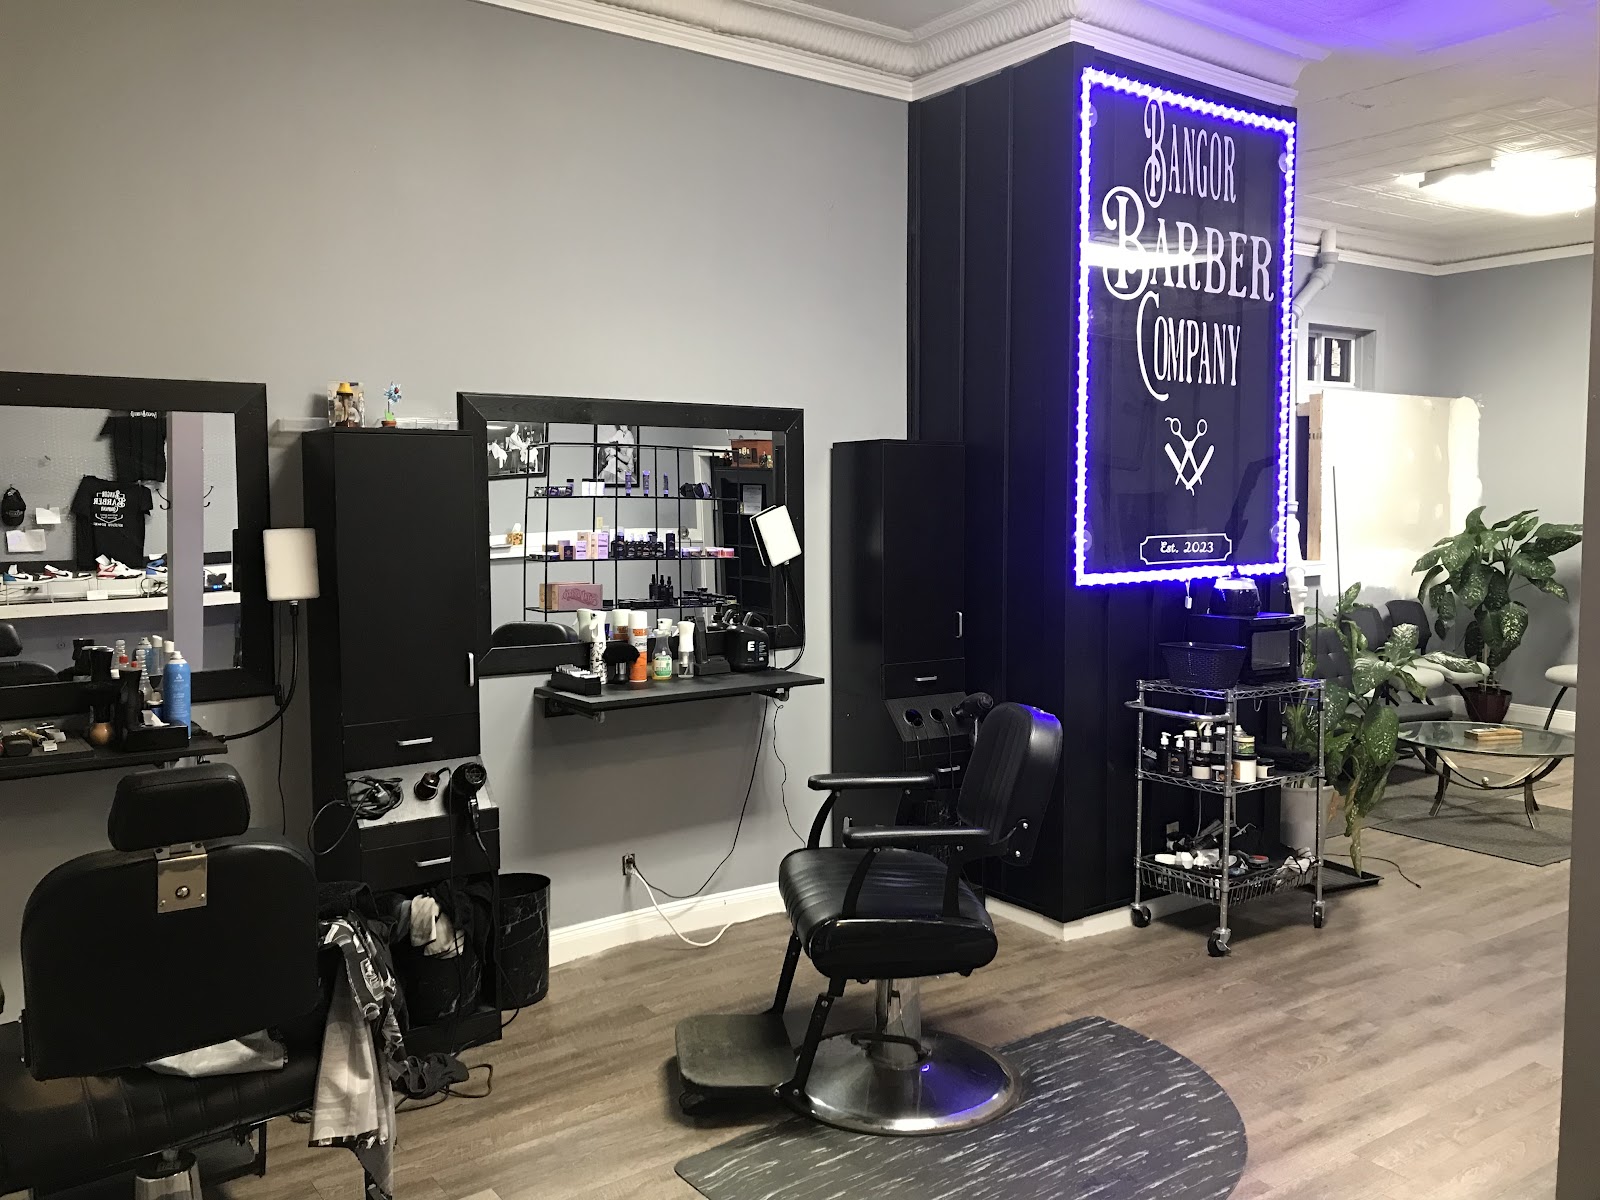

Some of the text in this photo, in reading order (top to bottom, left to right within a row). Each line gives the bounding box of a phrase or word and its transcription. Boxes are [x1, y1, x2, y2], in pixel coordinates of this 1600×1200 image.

[1143, 98, 1237, 208] BANGOR
[1102, 186, 1275, 302] BARBER
[1136, 290, 1241, 402] COMPANY
[1160, 541, 1214, 554] Est. 2023
